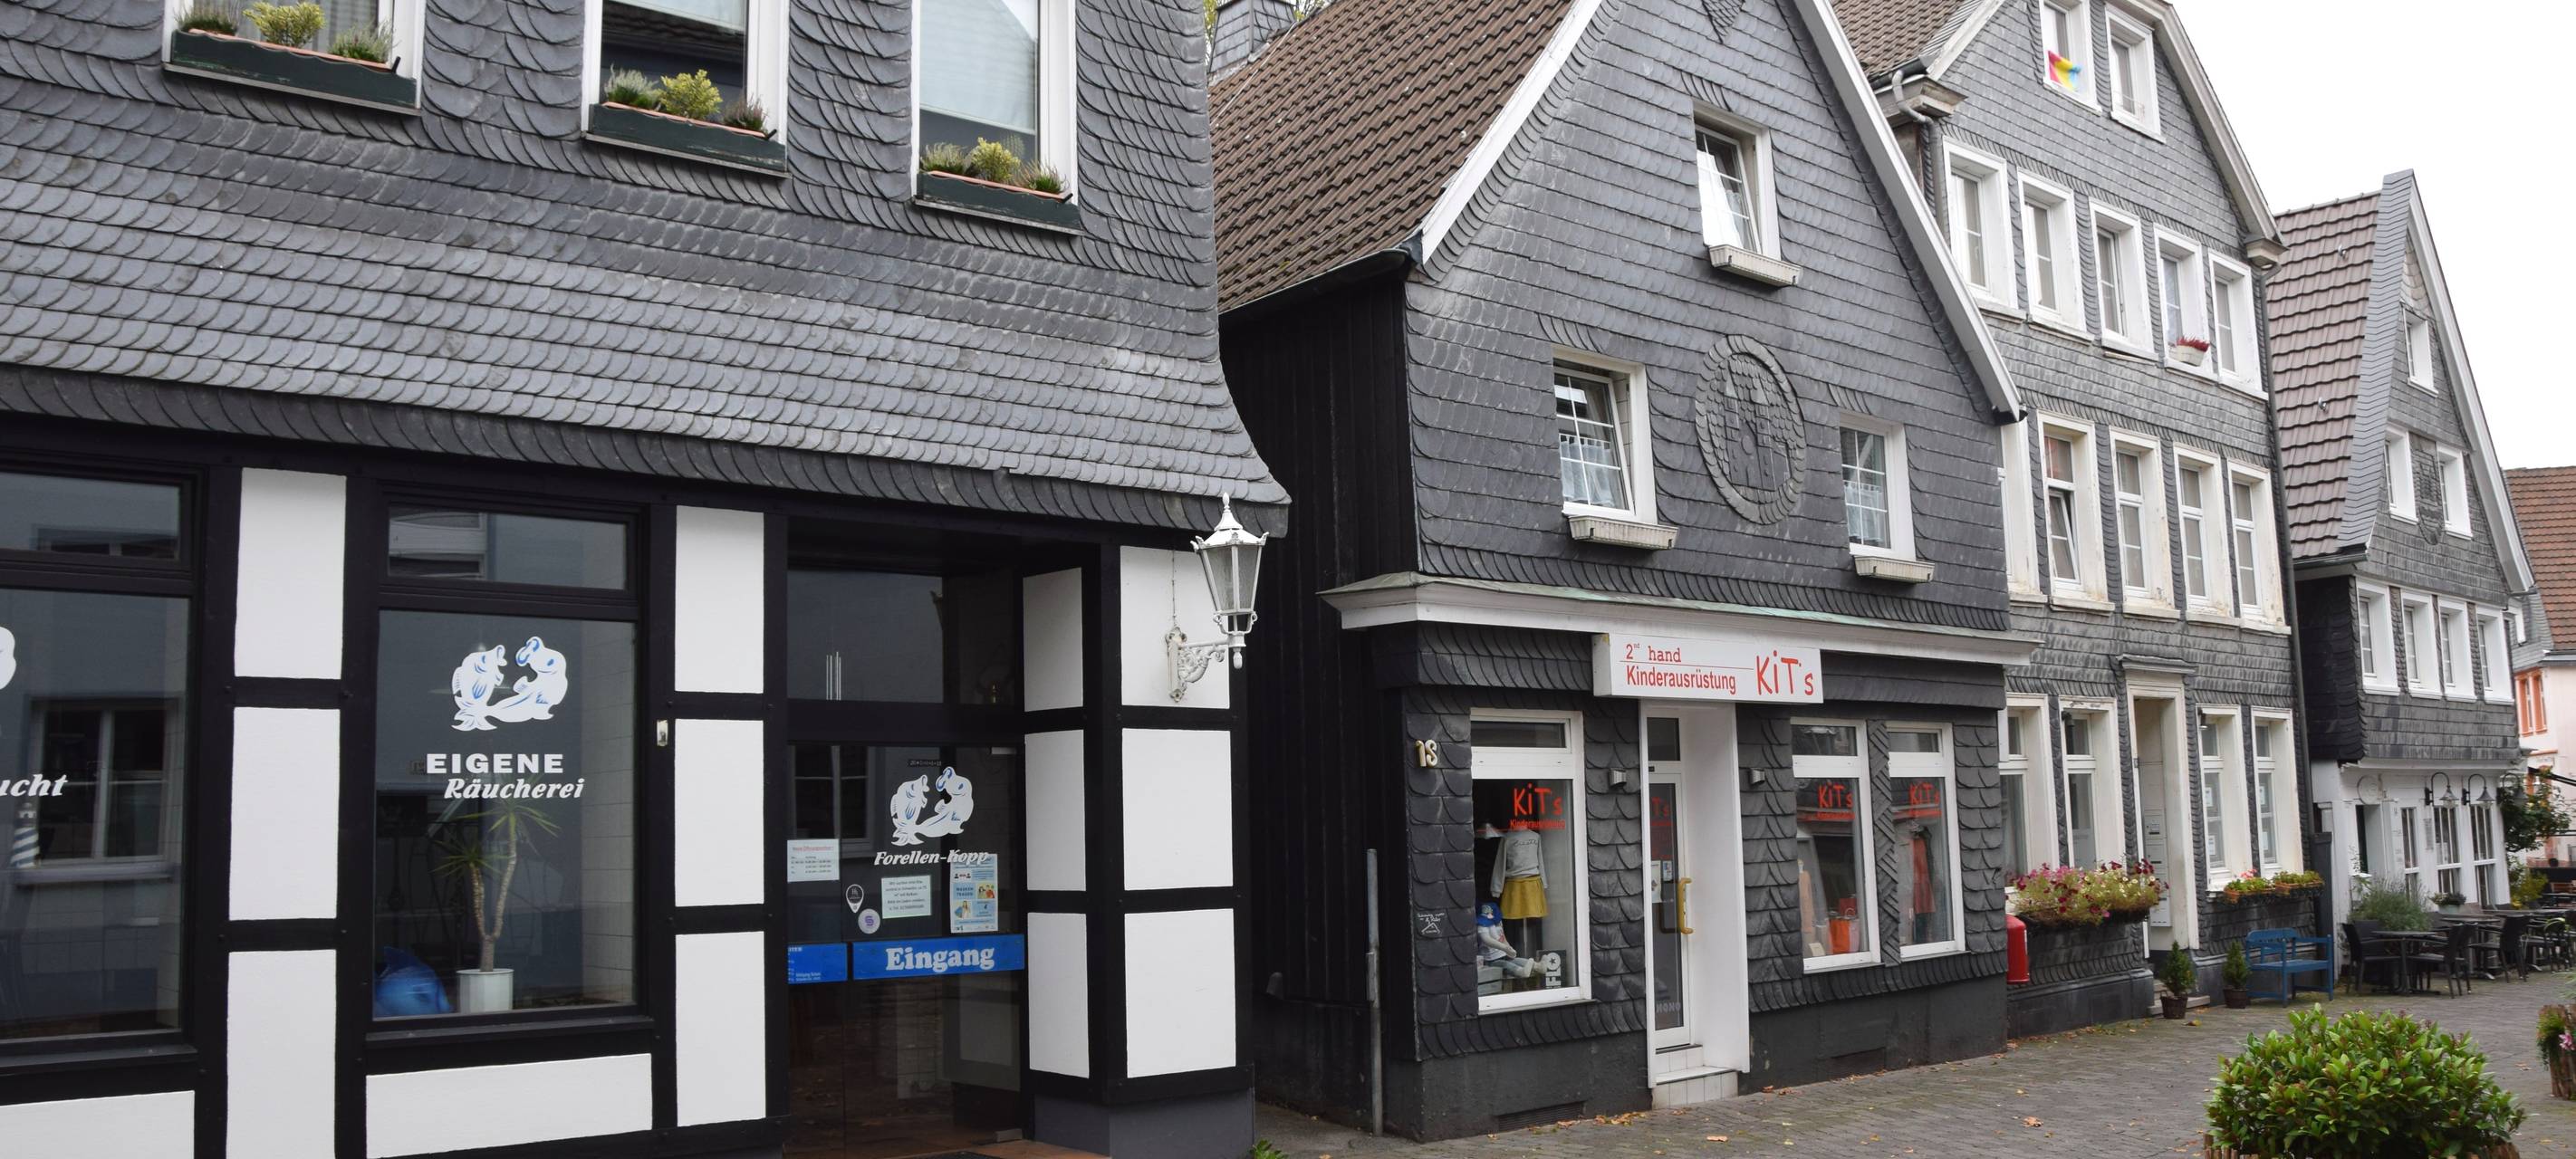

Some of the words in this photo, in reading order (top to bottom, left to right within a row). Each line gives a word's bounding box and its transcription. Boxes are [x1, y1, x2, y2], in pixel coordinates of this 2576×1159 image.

[1648, 646, 1682, 663] hand
[1626, 666, 1736, 694] Kinderausrüstung
[426, 753, 564, 774] EIGENE
[1415, 739, 1438, 768] 18
[443, 776, 585, 800] Räucherei
[885, 946, 995, 973] Eingang
